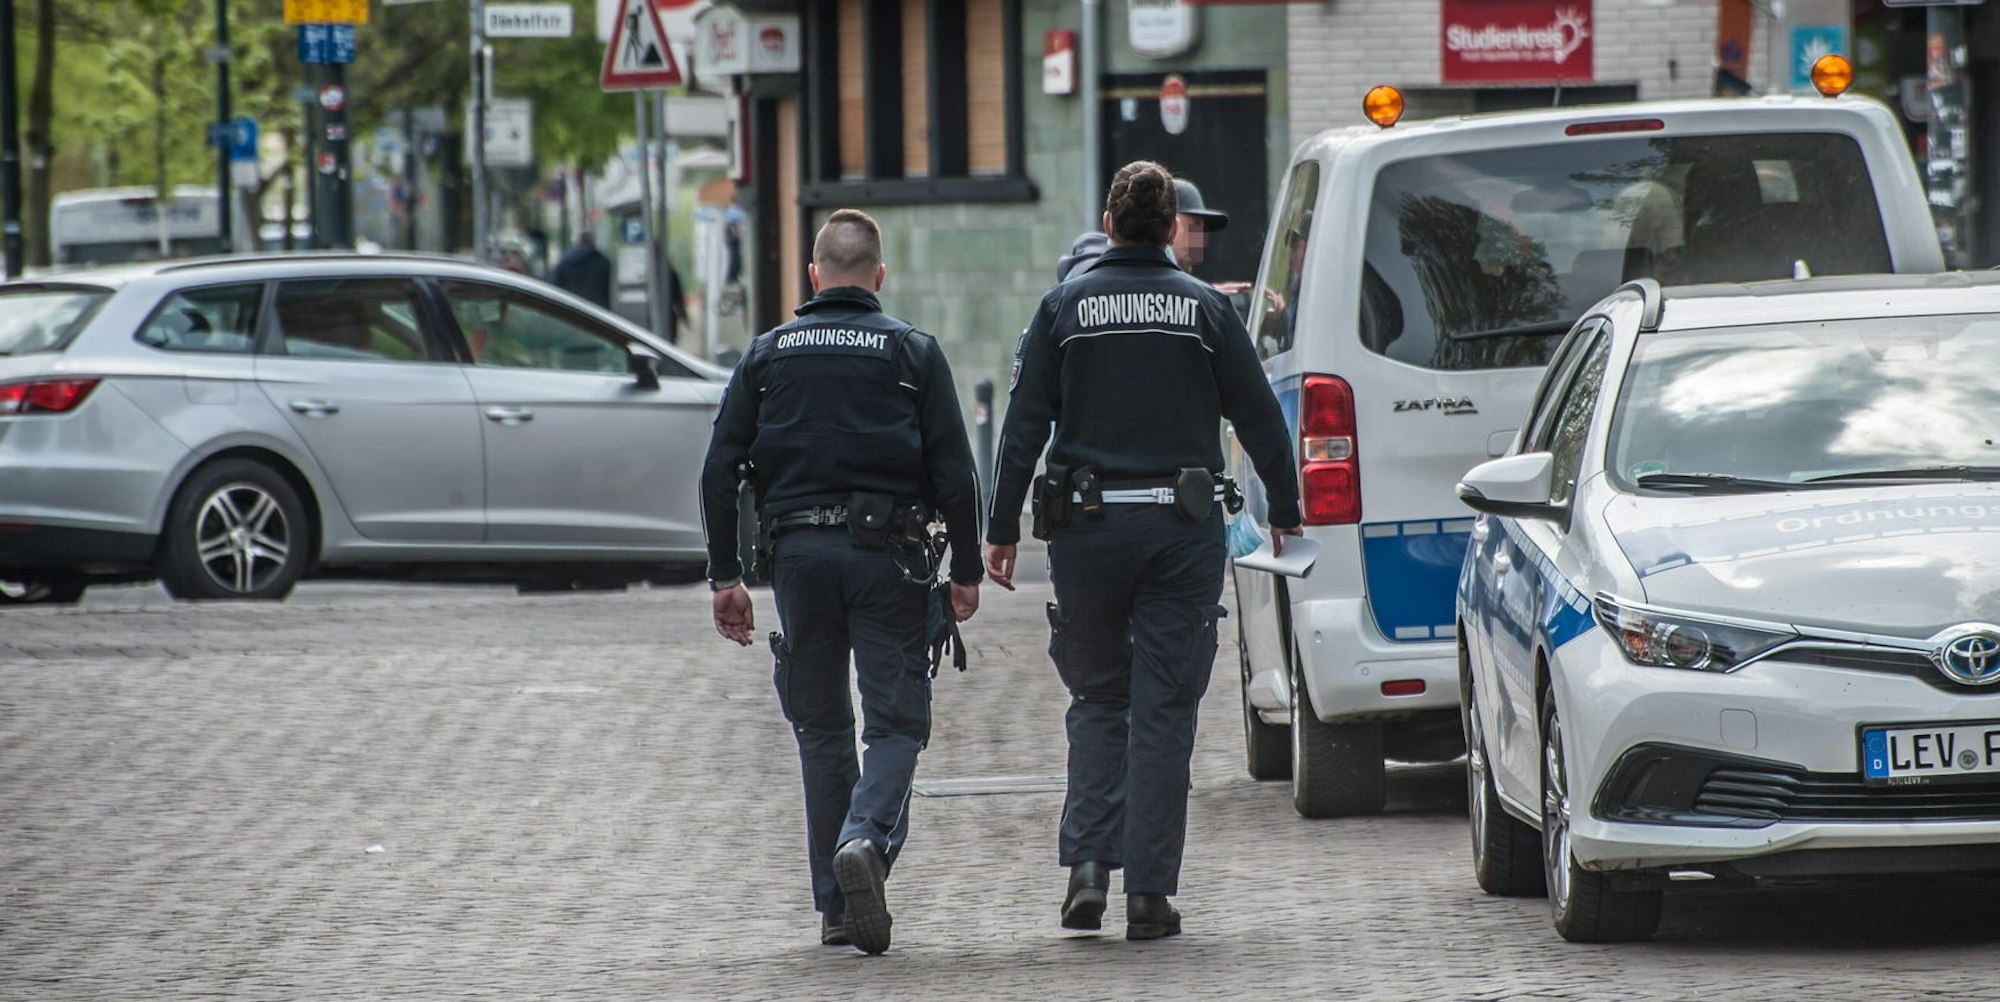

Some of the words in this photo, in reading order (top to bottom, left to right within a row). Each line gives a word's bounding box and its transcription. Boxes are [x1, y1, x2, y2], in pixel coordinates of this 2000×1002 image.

[1446, 22, 1563, 51] Studienkreis
[1077, 292, 1199, 328] ORDNUNGSAMT
[777, 328, 888, 351] ORDNUNGSAMT
[1392, 395, 1474, 413] ZAFIRA
[1873, 759, 1882, 770] D
[1890, 732, 1955, 771] LEV
